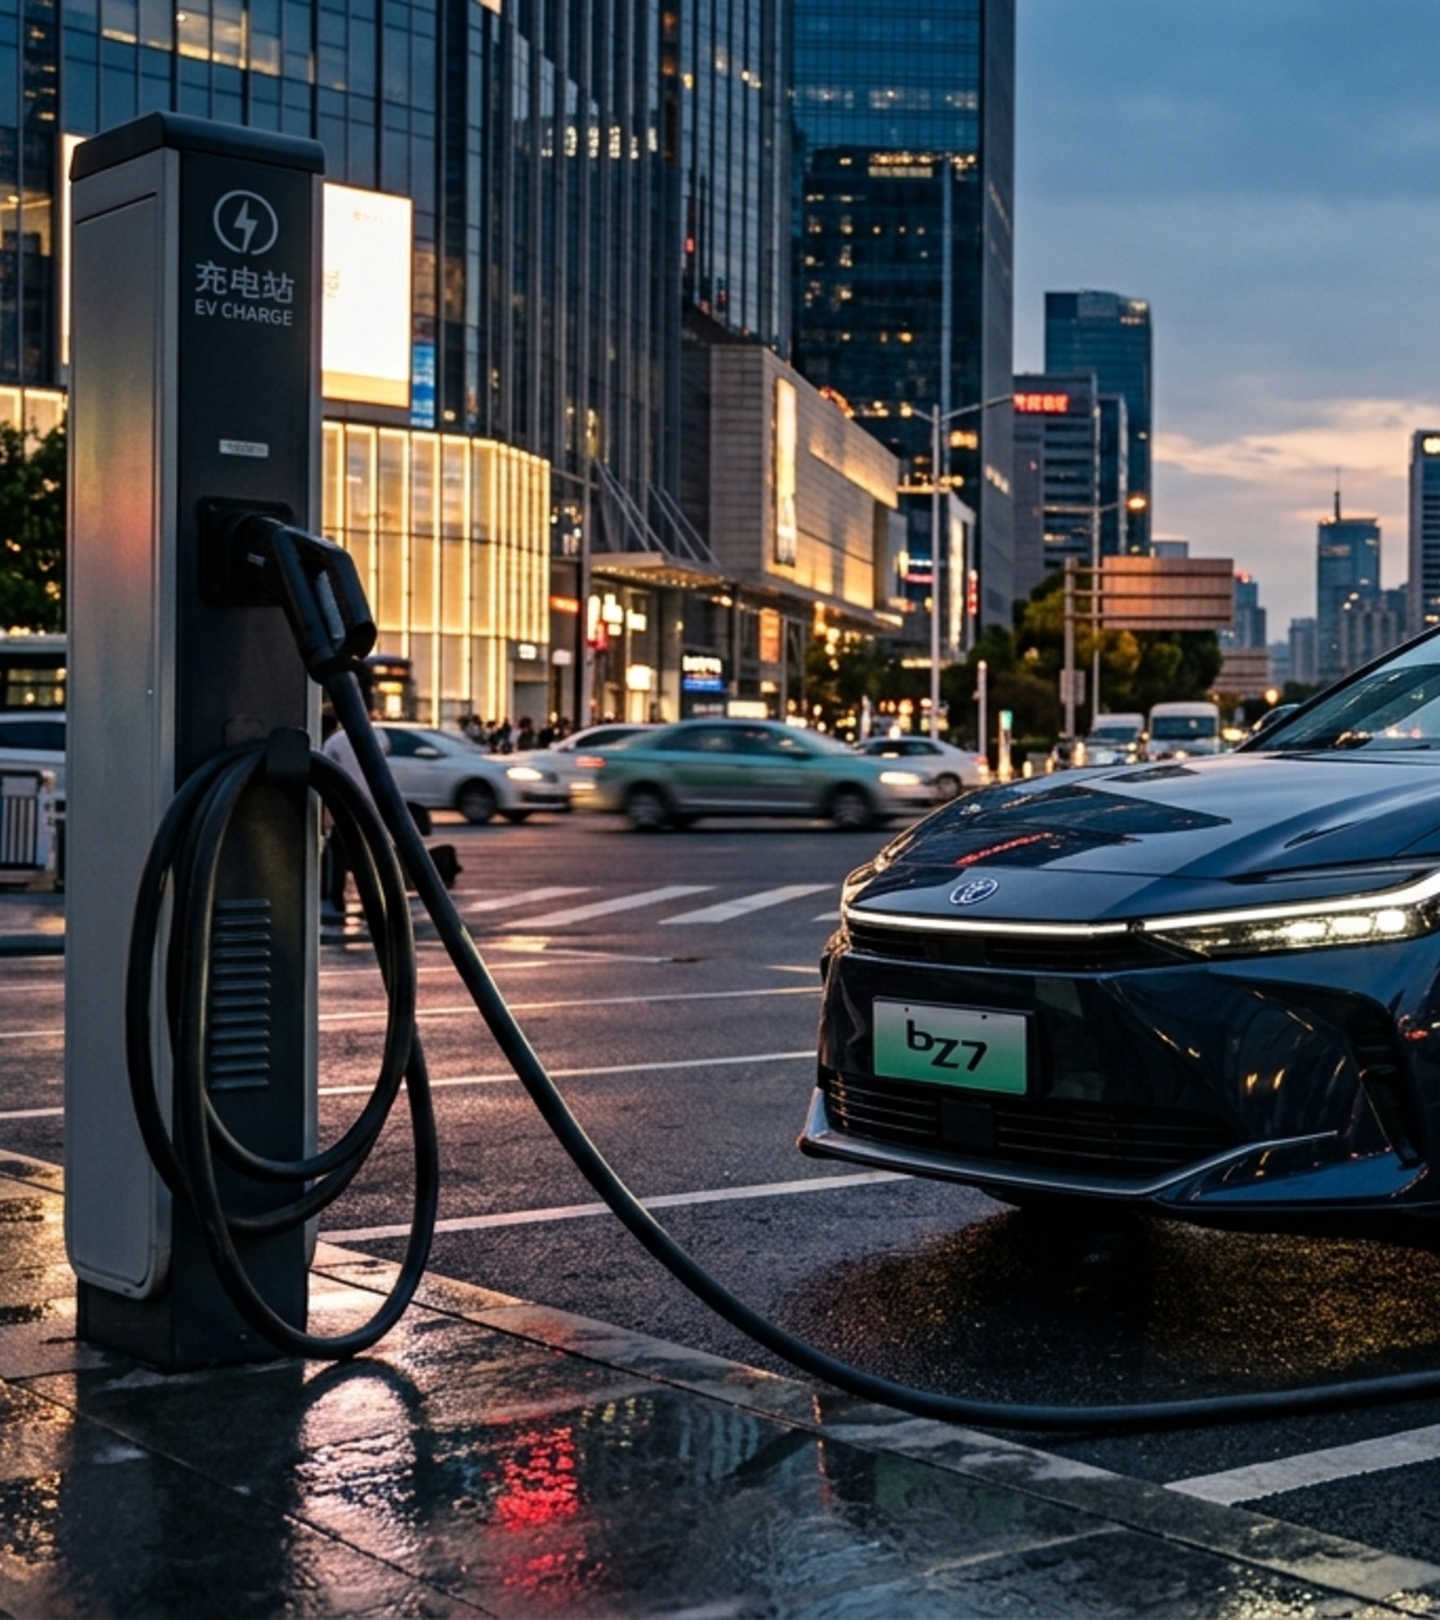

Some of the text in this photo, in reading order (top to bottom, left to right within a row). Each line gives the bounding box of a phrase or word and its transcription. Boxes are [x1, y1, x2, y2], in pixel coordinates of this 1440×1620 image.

[195, 260, 295, 304] 充电站
[195, 299, 293, 326] EV CHARGE
